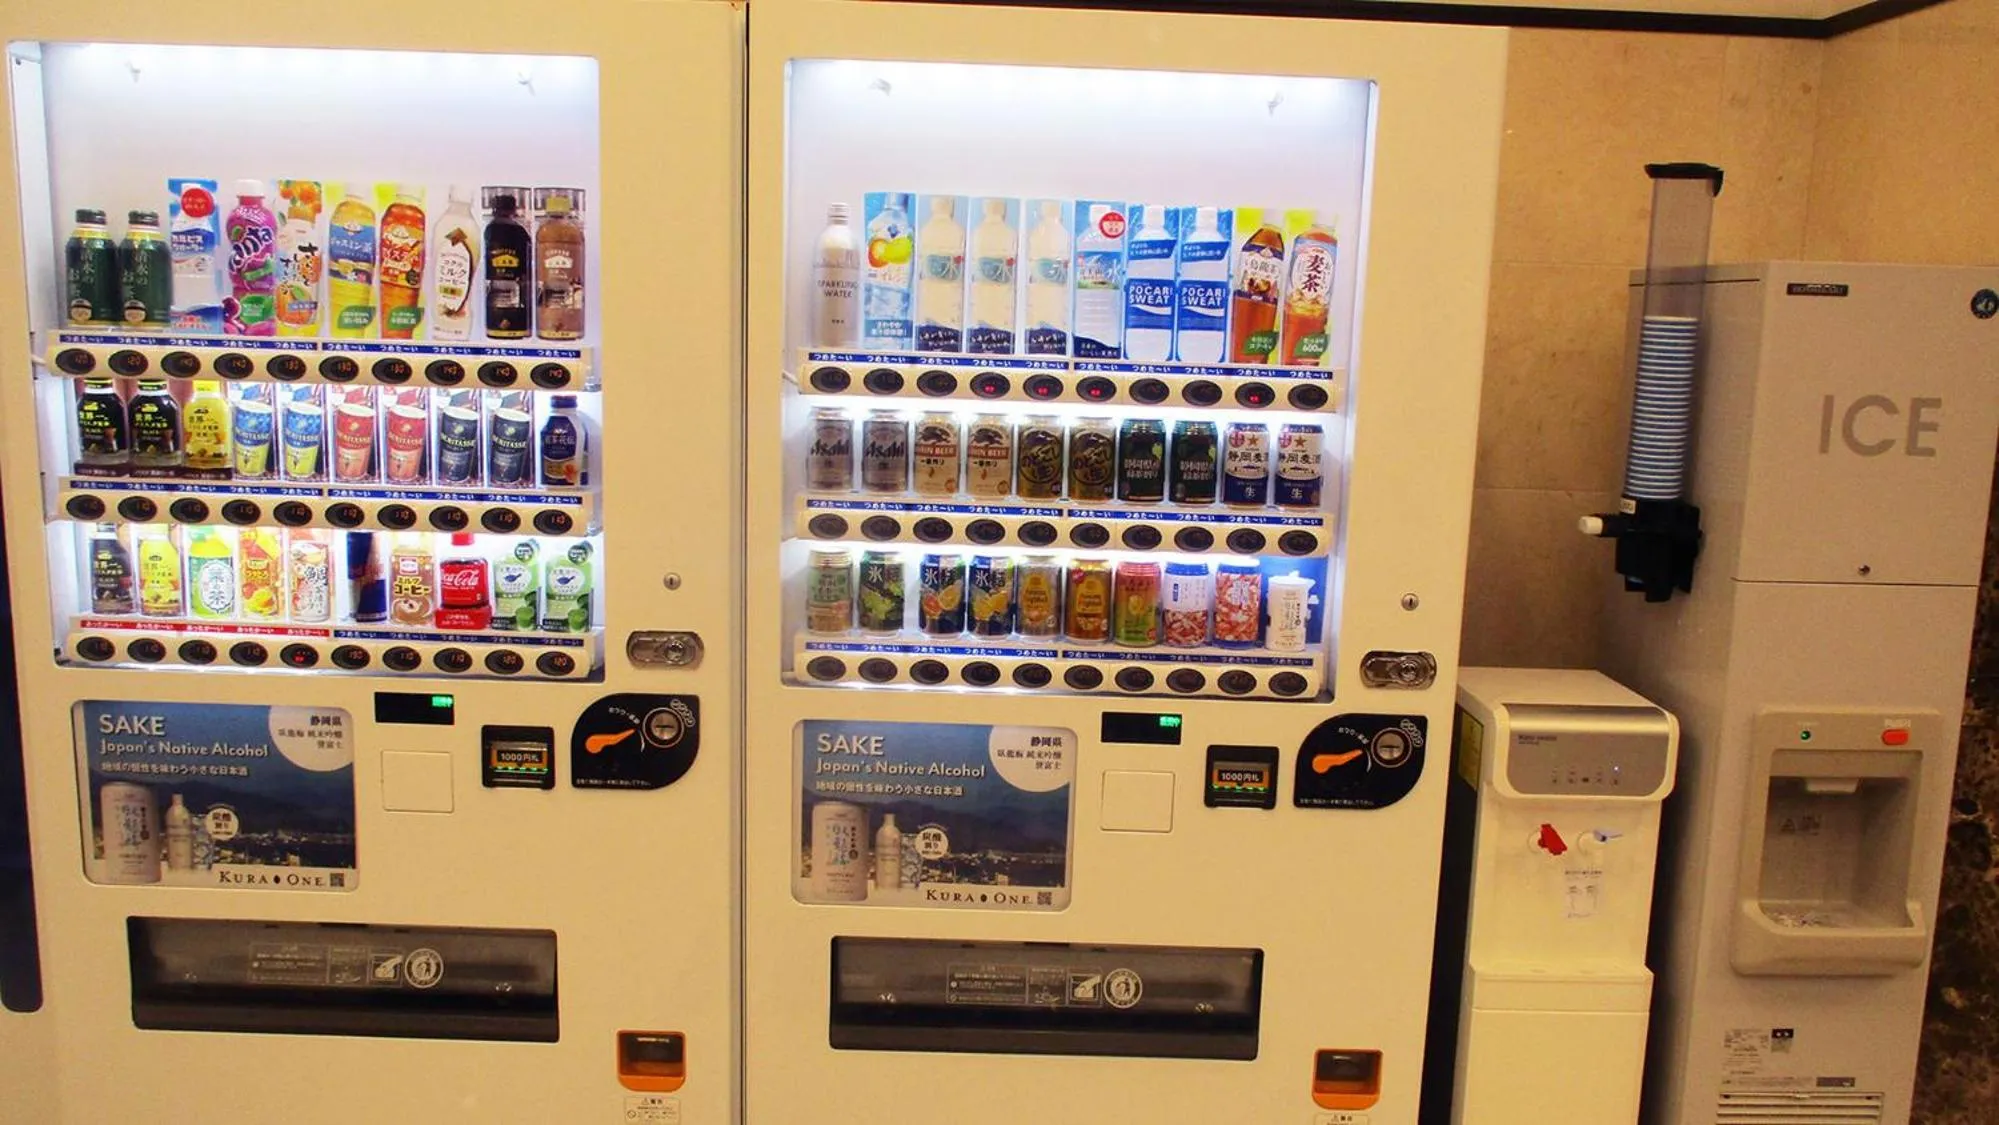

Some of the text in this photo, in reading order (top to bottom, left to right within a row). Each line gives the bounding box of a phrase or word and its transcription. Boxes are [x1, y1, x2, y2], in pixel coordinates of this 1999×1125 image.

[1302, 254, 1323, 293] 麦茶
[824, 289, 853, 298] WATER
[1129, 286, 1173, 295] POCARI
[1182, 287, 1225, 297] POCARI
[1129, 296, 1169, 304] SWEAT
[1182, 297, 1222, 306] SWEAT
[1818, 394, 1943, 457] ICE
[810, 439, 850, 455] Asahi
[865, 440, 905, 458] Asahi
[394, 585, 430, 595] コーヒー
[100, 713, 166, 736] SAKE
[100, 740, 269, 758] Japan's Native Alcohol
[817, 733, 885, 756] SAKE
[816, 758, 985, 777] Japan's Native Alcohol
[816, 781, 964, 797] 地域の個性を味わう小さな日本酒
[220, 872, 268, 885] KURA
[926, 890, 975, 904] KURA
